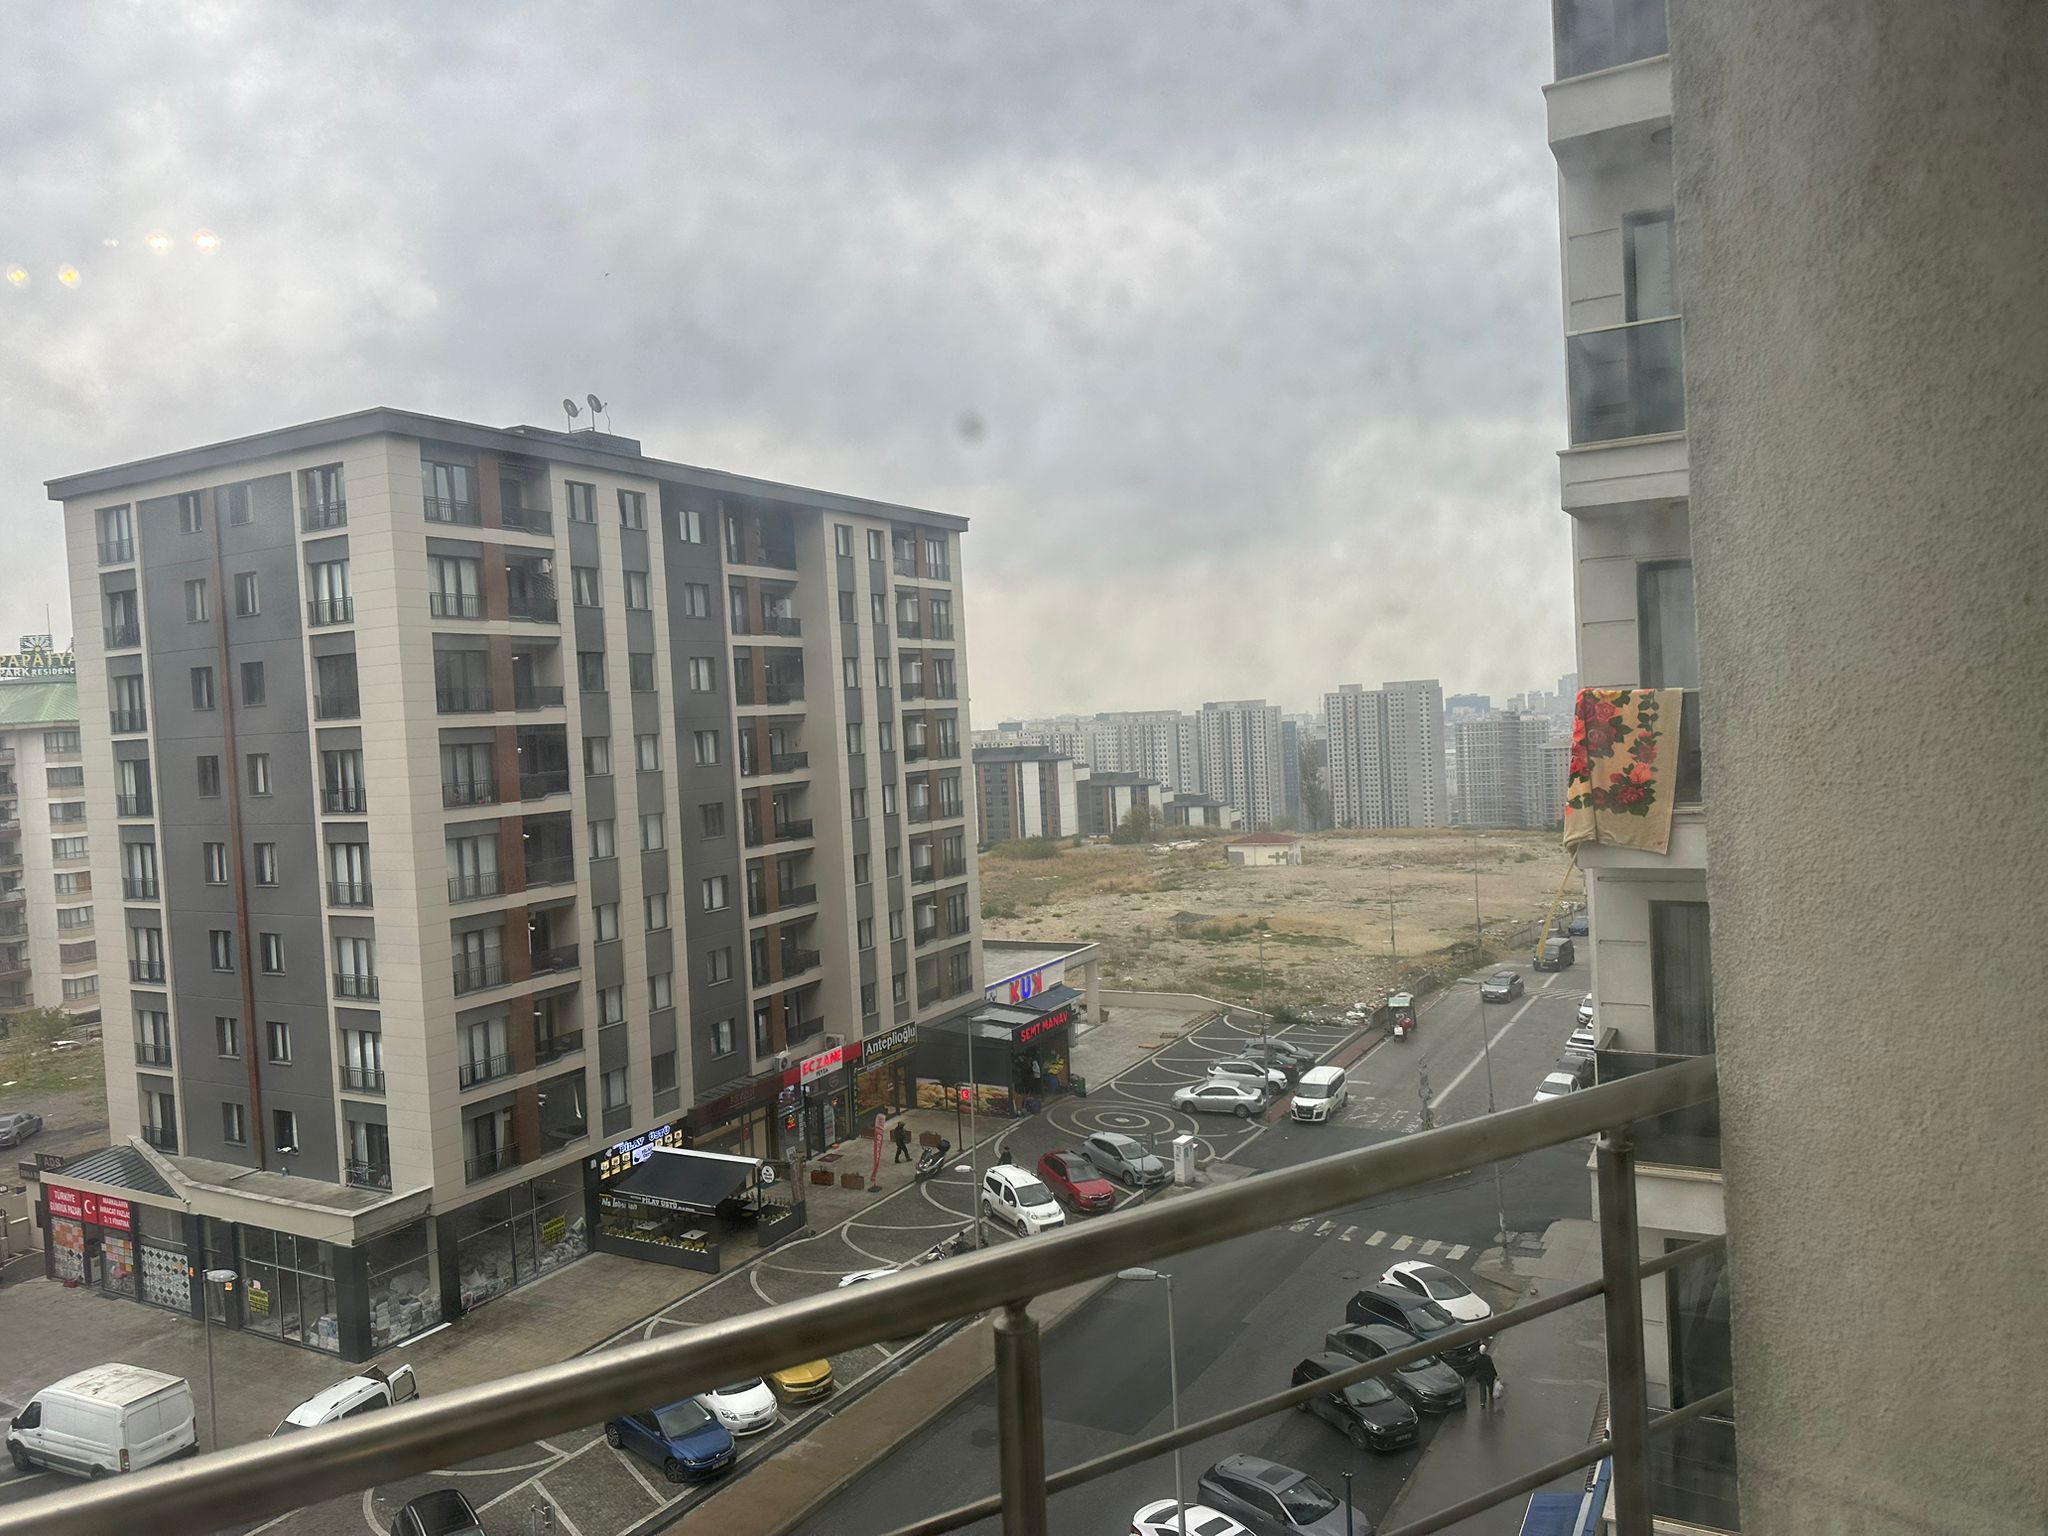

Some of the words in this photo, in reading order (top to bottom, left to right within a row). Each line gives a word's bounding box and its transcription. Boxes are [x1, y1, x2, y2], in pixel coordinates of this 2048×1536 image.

[0, 651, 76, 668] PAPATYA
[0, 667, 31, 677] PARK
[31, 667, 75, 677] RESIDENC
[1021, 1023, 1041, 1042] SEMT
[1042, 1011, 1068, 1032] MANAV
[865, 1025, 916, 1057] Anteplioğlu
[802, 1047, 843, 1076] ECZANE
[619, 1137, 645, 1154] PİLAV
[648, 1125, 671, 1141] ÜSTÜ
[54, 1190, 75, 1203] TÜRKİYE
[642, 1197, 660, 1206] PİLAV
[660, 1199, 678, 1209] ÜSTÜ
